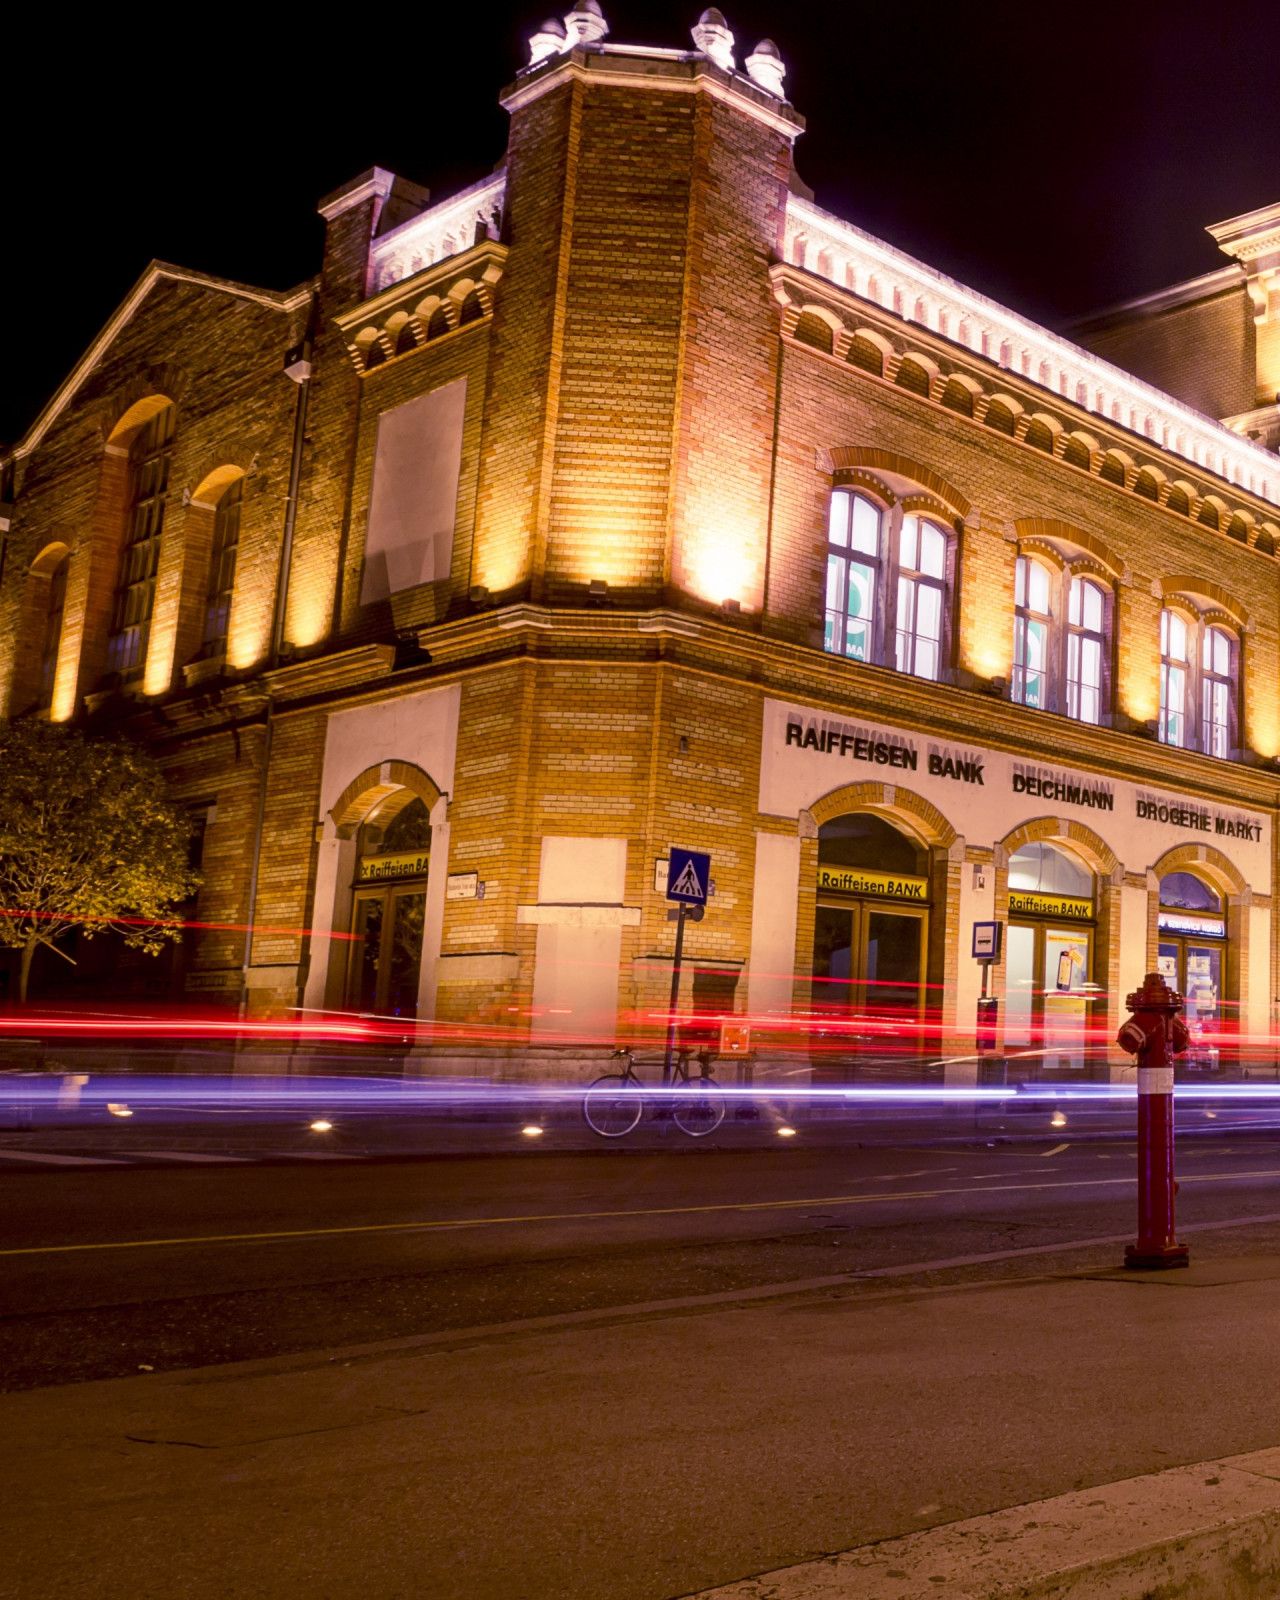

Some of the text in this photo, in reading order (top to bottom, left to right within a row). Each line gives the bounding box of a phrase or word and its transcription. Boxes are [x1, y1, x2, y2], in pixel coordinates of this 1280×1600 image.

[785, 722, 985, 786] RAIFFEISEN BANK
[1012, 774, 1114, 812] DEICHMANN
[1136, 800, 1263, 843] DROGERIE MARKT
[370, 860, 415, 878] Raiffeisen
[822, 872, 922, 898] Raiffeisen BANK
[1009, 896, 1090, 917] Raiffeisen BANK
